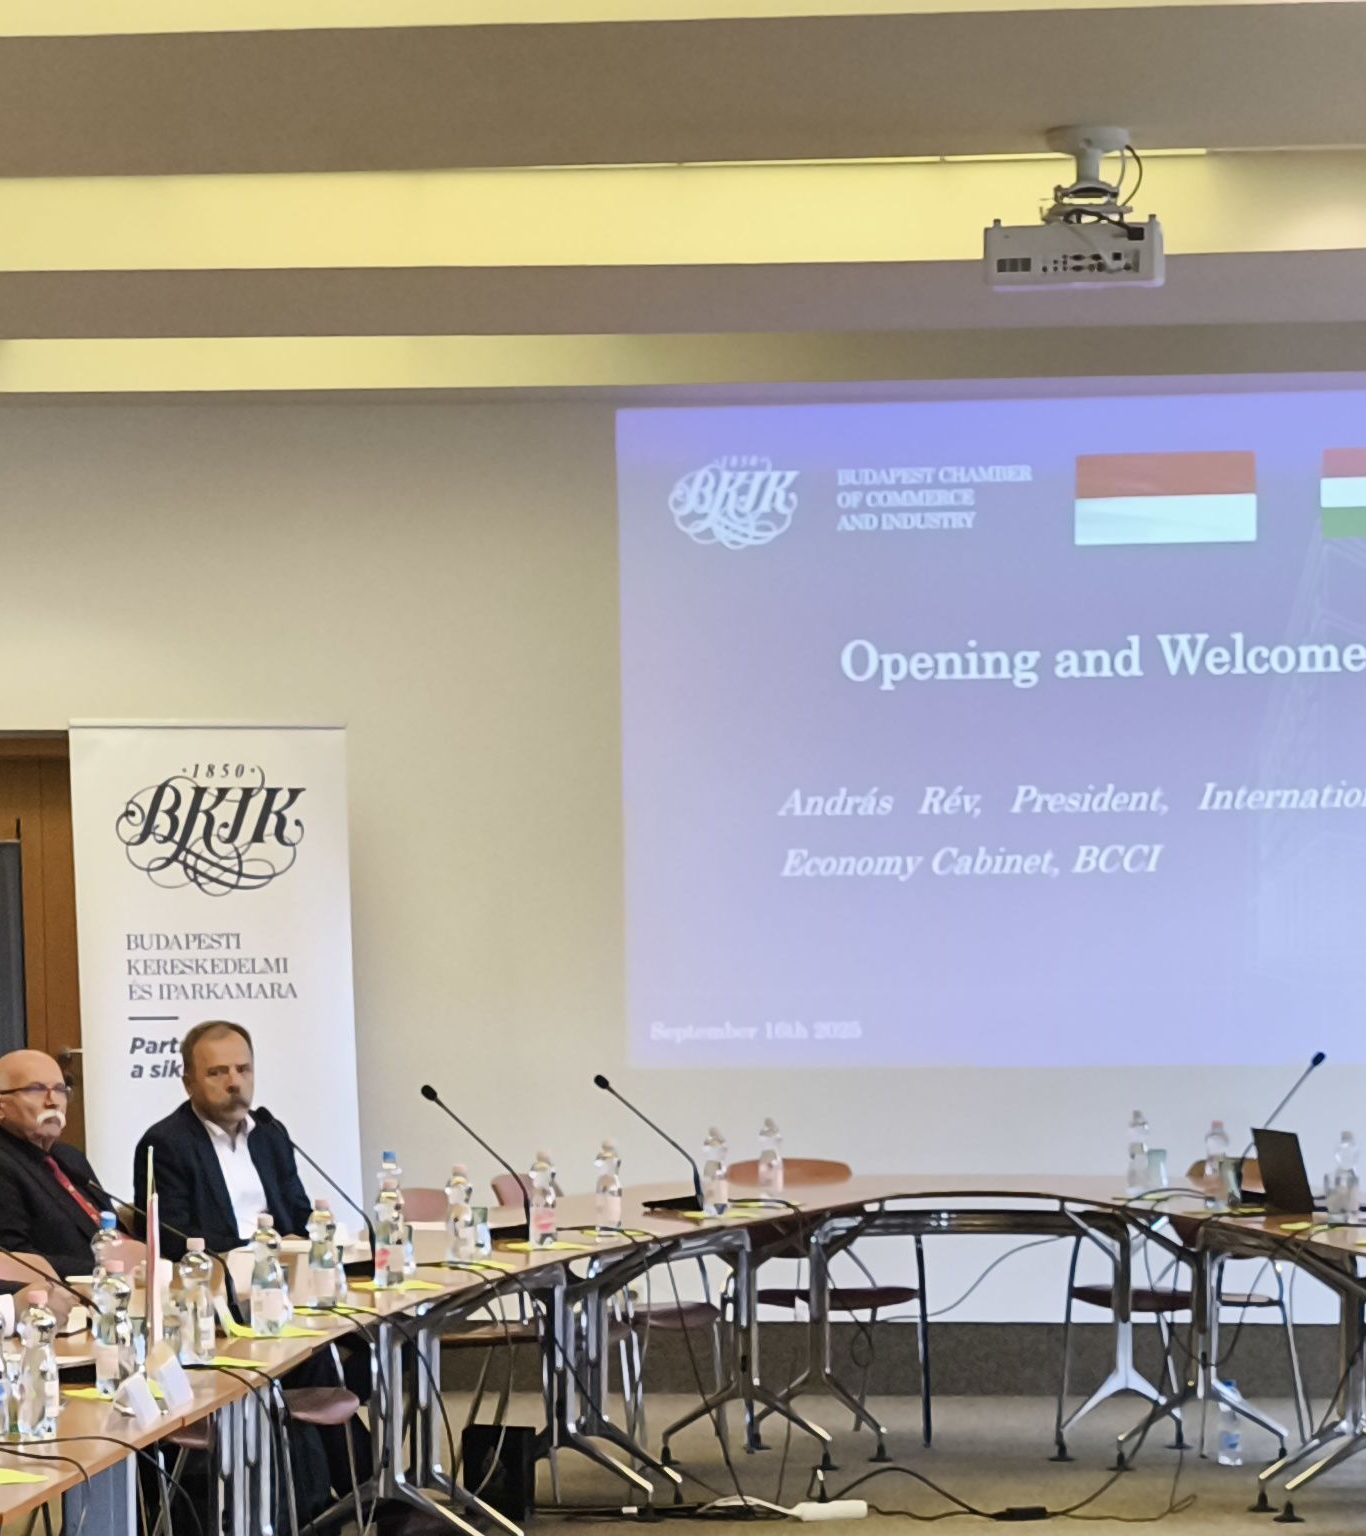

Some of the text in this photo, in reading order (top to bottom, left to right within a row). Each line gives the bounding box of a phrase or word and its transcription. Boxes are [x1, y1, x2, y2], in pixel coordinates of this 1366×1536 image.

[837, 465, 1033, 485] BUDAPEST CHAMBER
[837, 489, 976, 508] OF COMMERCE
[837, 511, 976, 531] AND INDUSTRY
[841, 639, 1040, 690] Opening
[1053, 636, 1143, 678] and
[192, 763, 246, 778] 1850
[777, 787, 894, 817] András
[918, 786, 982, 818] Rév,
[1010, 784, 1169, 815] President,
[781, 844, 1166, 882] Economy Cabinet, BCCI
[126, 933, 242, 950] BUDAPESTI
[126, 957, 290, 976] KERESKEDELMI
[159, 982, 299, 1001] IPARKAMARA
[130, 1036, 183, 1054] Part
[131, 1060, 185, 1079] a sik
